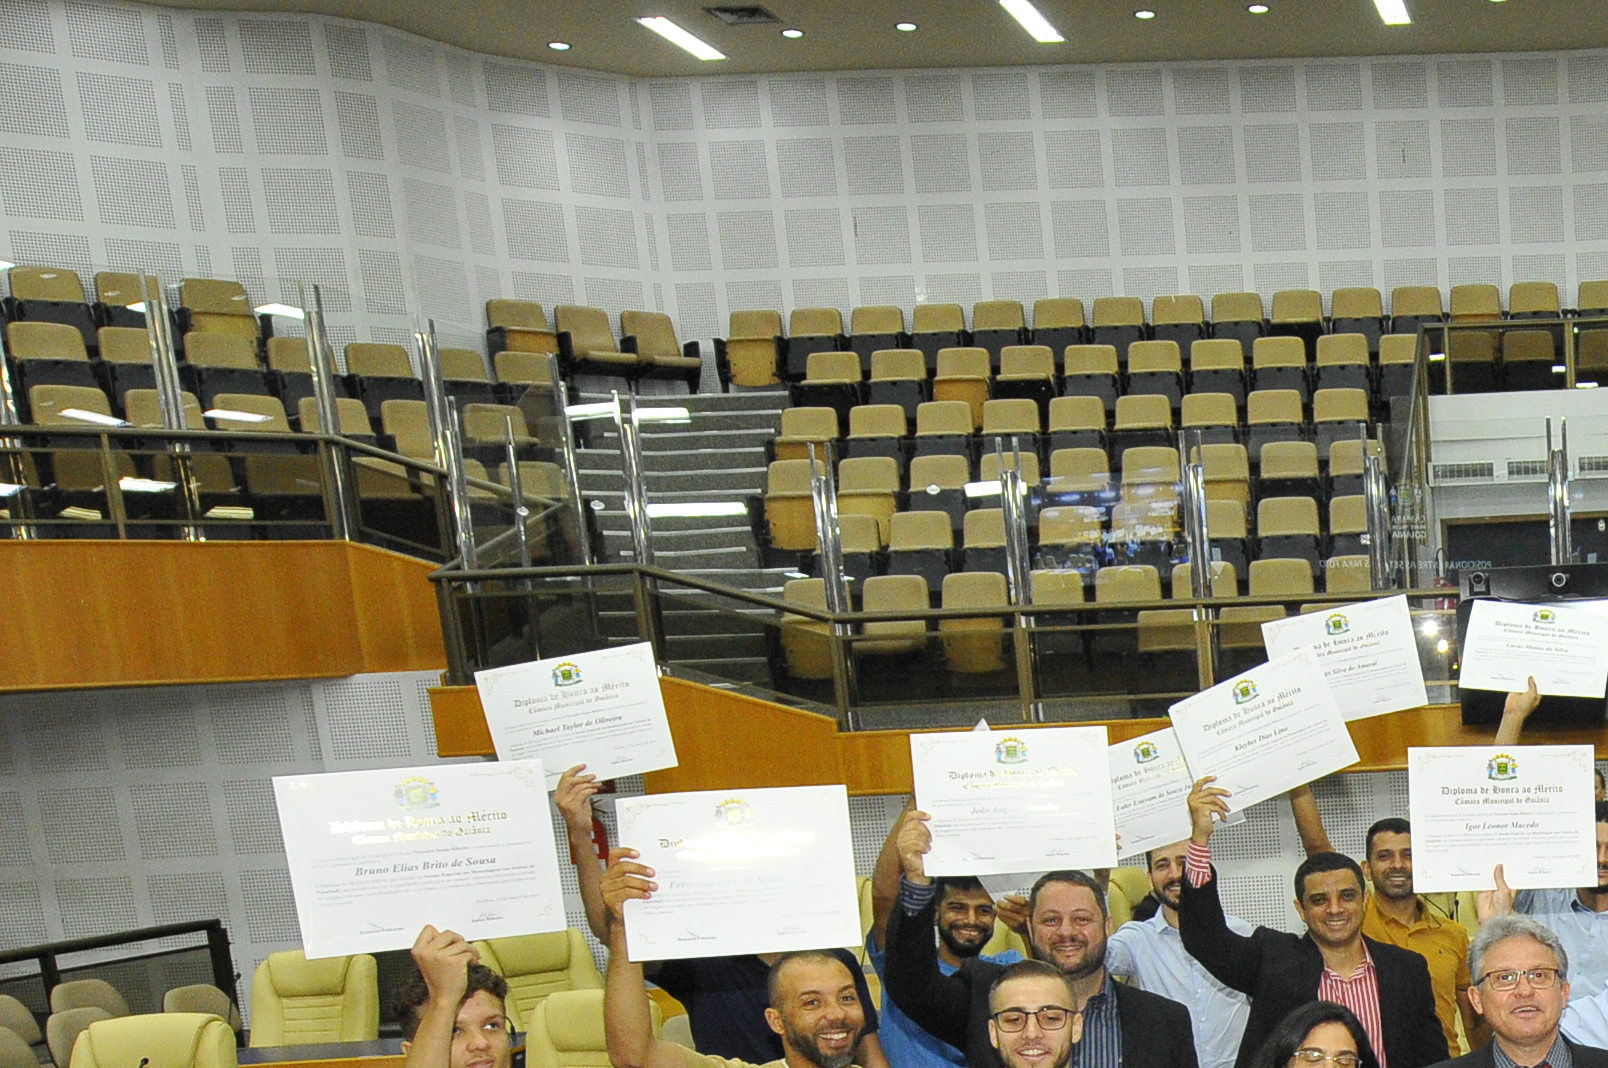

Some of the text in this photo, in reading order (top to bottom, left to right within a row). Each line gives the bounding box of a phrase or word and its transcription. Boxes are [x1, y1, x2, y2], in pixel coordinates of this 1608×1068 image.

[1110, 772, 1133, 784] iploma
[1440, 785, 1478, 795] Diploma
[1479, 785, 1489, 794] de
[1491, 784, 1519, 794] Honra
[1533, 783, 1563, 794] Mérito
[1464, 820, 1539, 831] Igor Leonor Macedo
[354, 856, 496, 876] Bruno Elias Brito de Sousa
